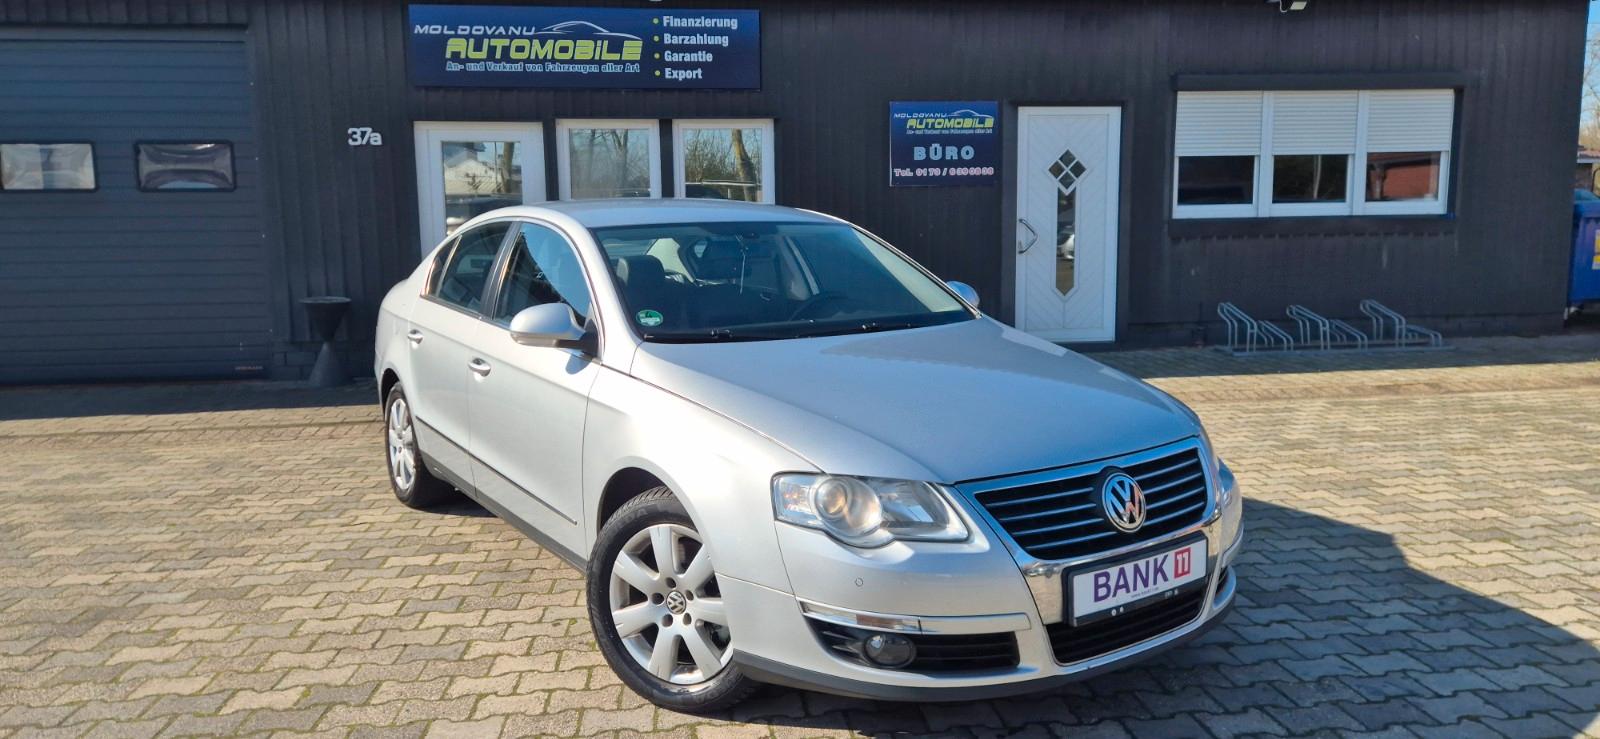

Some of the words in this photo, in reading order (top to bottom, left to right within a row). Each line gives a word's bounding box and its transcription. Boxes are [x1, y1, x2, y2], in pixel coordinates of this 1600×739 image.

[662, 15, 739, 30] Finanzierung
[414, 24, 536, 36] MOLDOVANU
[663, 33, 729, 47] Barzahlung
[664, 50, 714, 62] Garantie
[466, 61, 485, 71] und
[486, 61, 524, 72] Verkauf
[525, 63, 543, 71] von
[545, 62, 600, 74] Fahrzeugen
[601, 62, 623, 73] aller
[624, 63, 641, 72] Art
[665, 67, 703, 81] Export
[347, 126, 383, 146] 37a
[913, 143, 975, 161] BÜRO
[1093, 553, 1170, 603] BANK
[1175, 550, 1190, 577] 11
